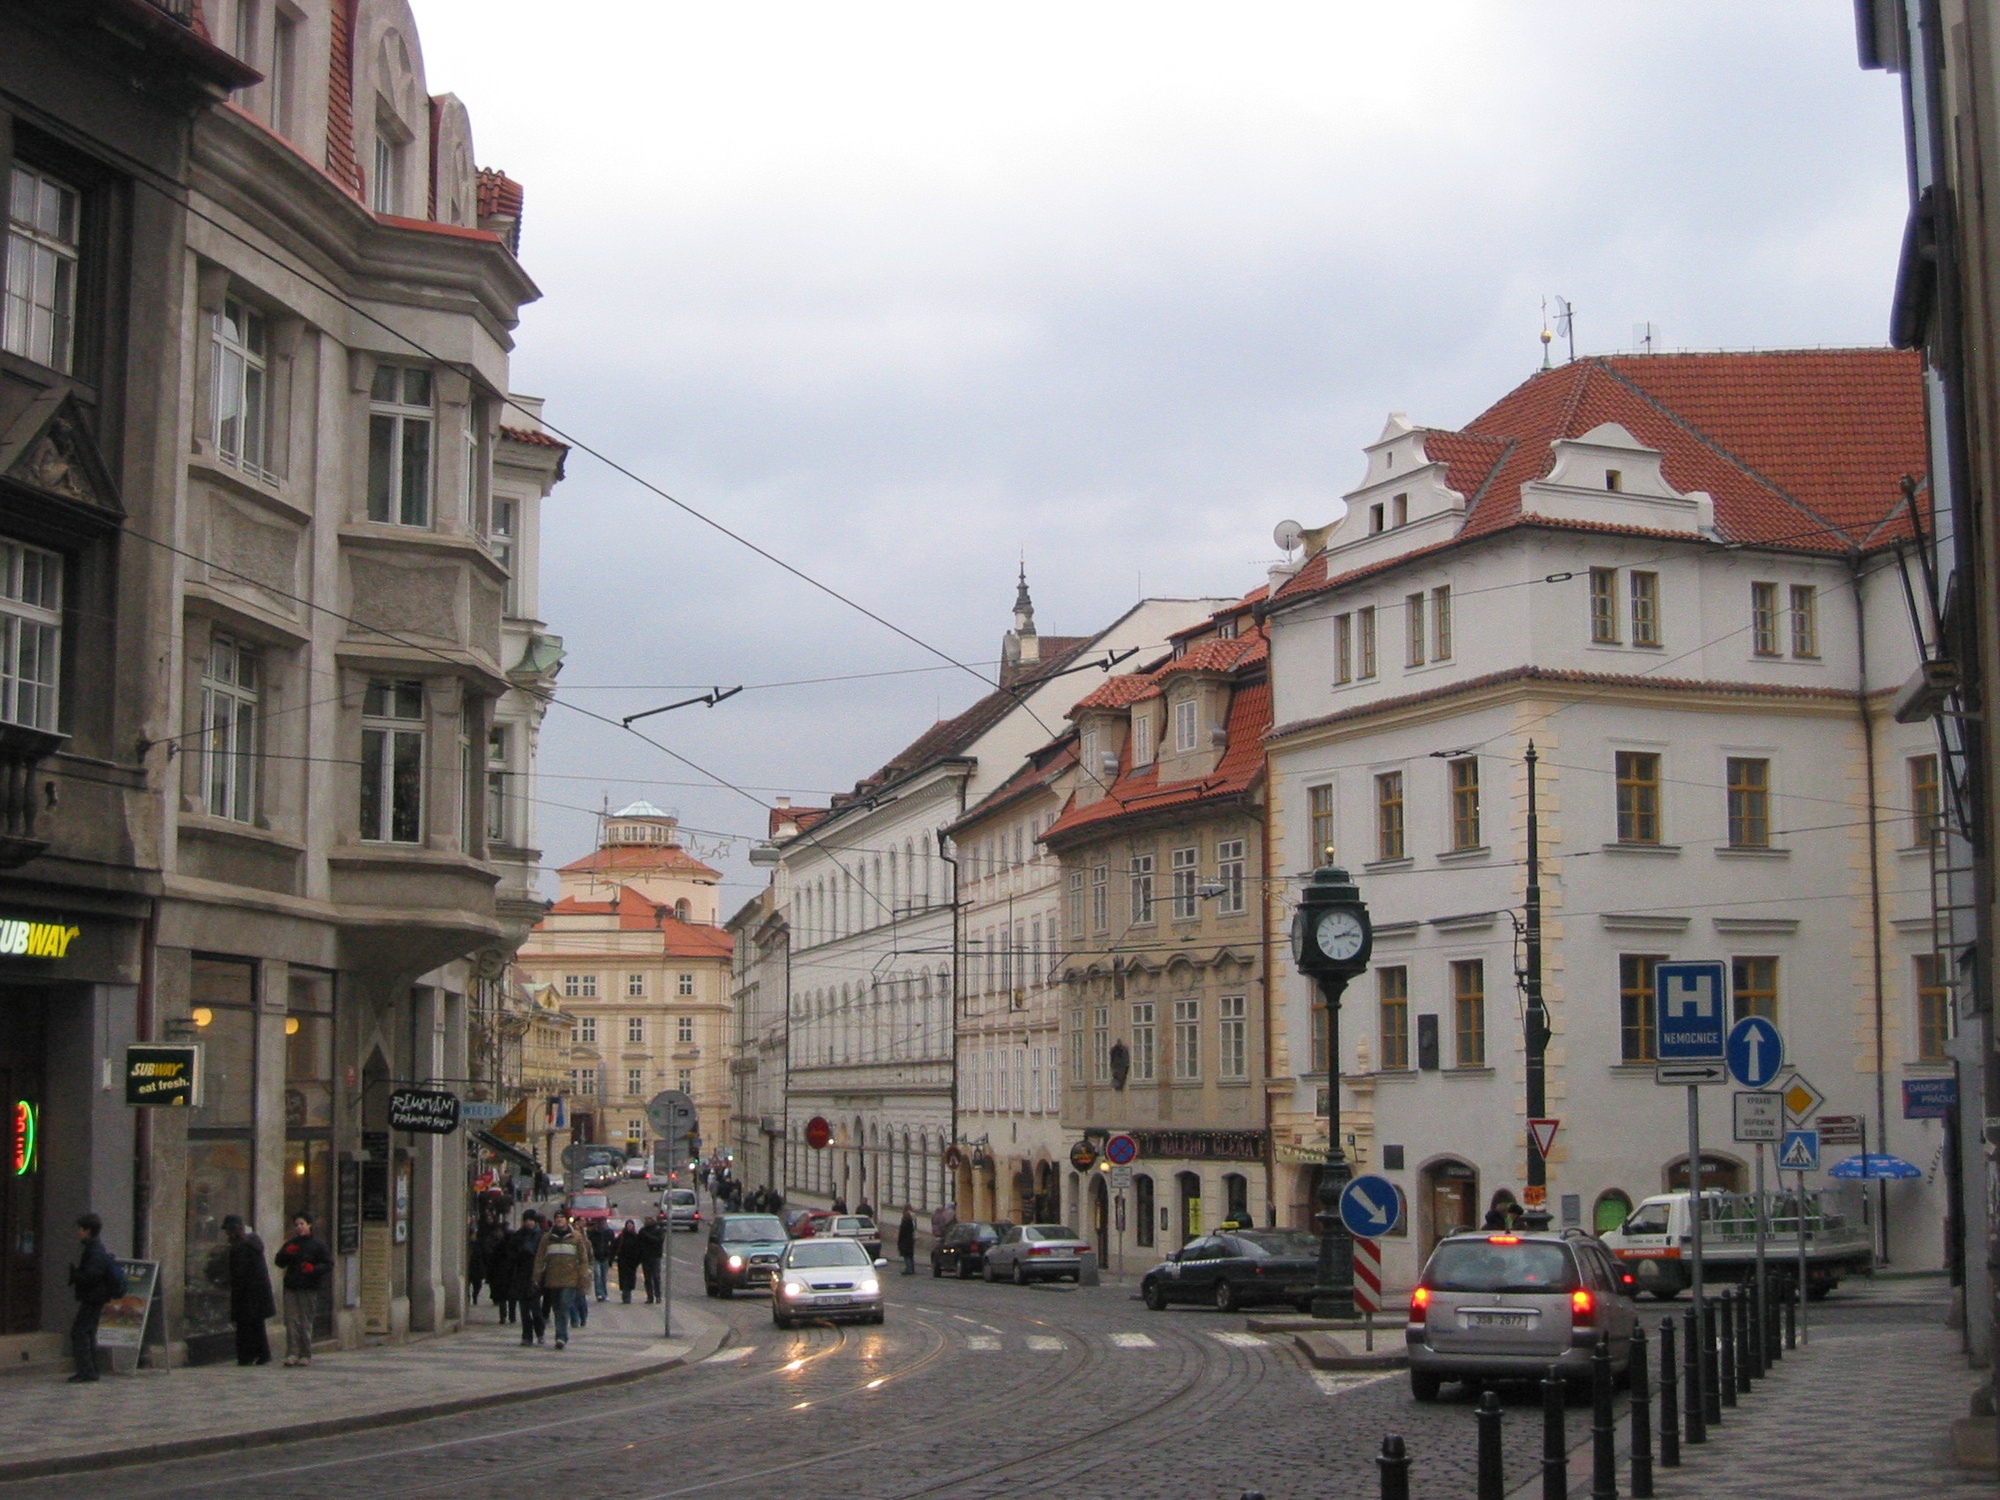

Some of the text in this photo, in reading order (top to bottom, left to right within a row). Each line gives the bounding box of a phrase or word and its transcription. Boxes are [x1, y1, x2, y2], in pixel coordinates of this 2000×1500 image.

[0, 919, 80, 958] UBWAY
[1667, 975, 1713, 1017] H
[1664, 1032, 1718, 1045] NEMOCNICE
[131, 1062, 184, 1077] SUBWAY
[138, 1077, 190, 1094] eat fresh.
